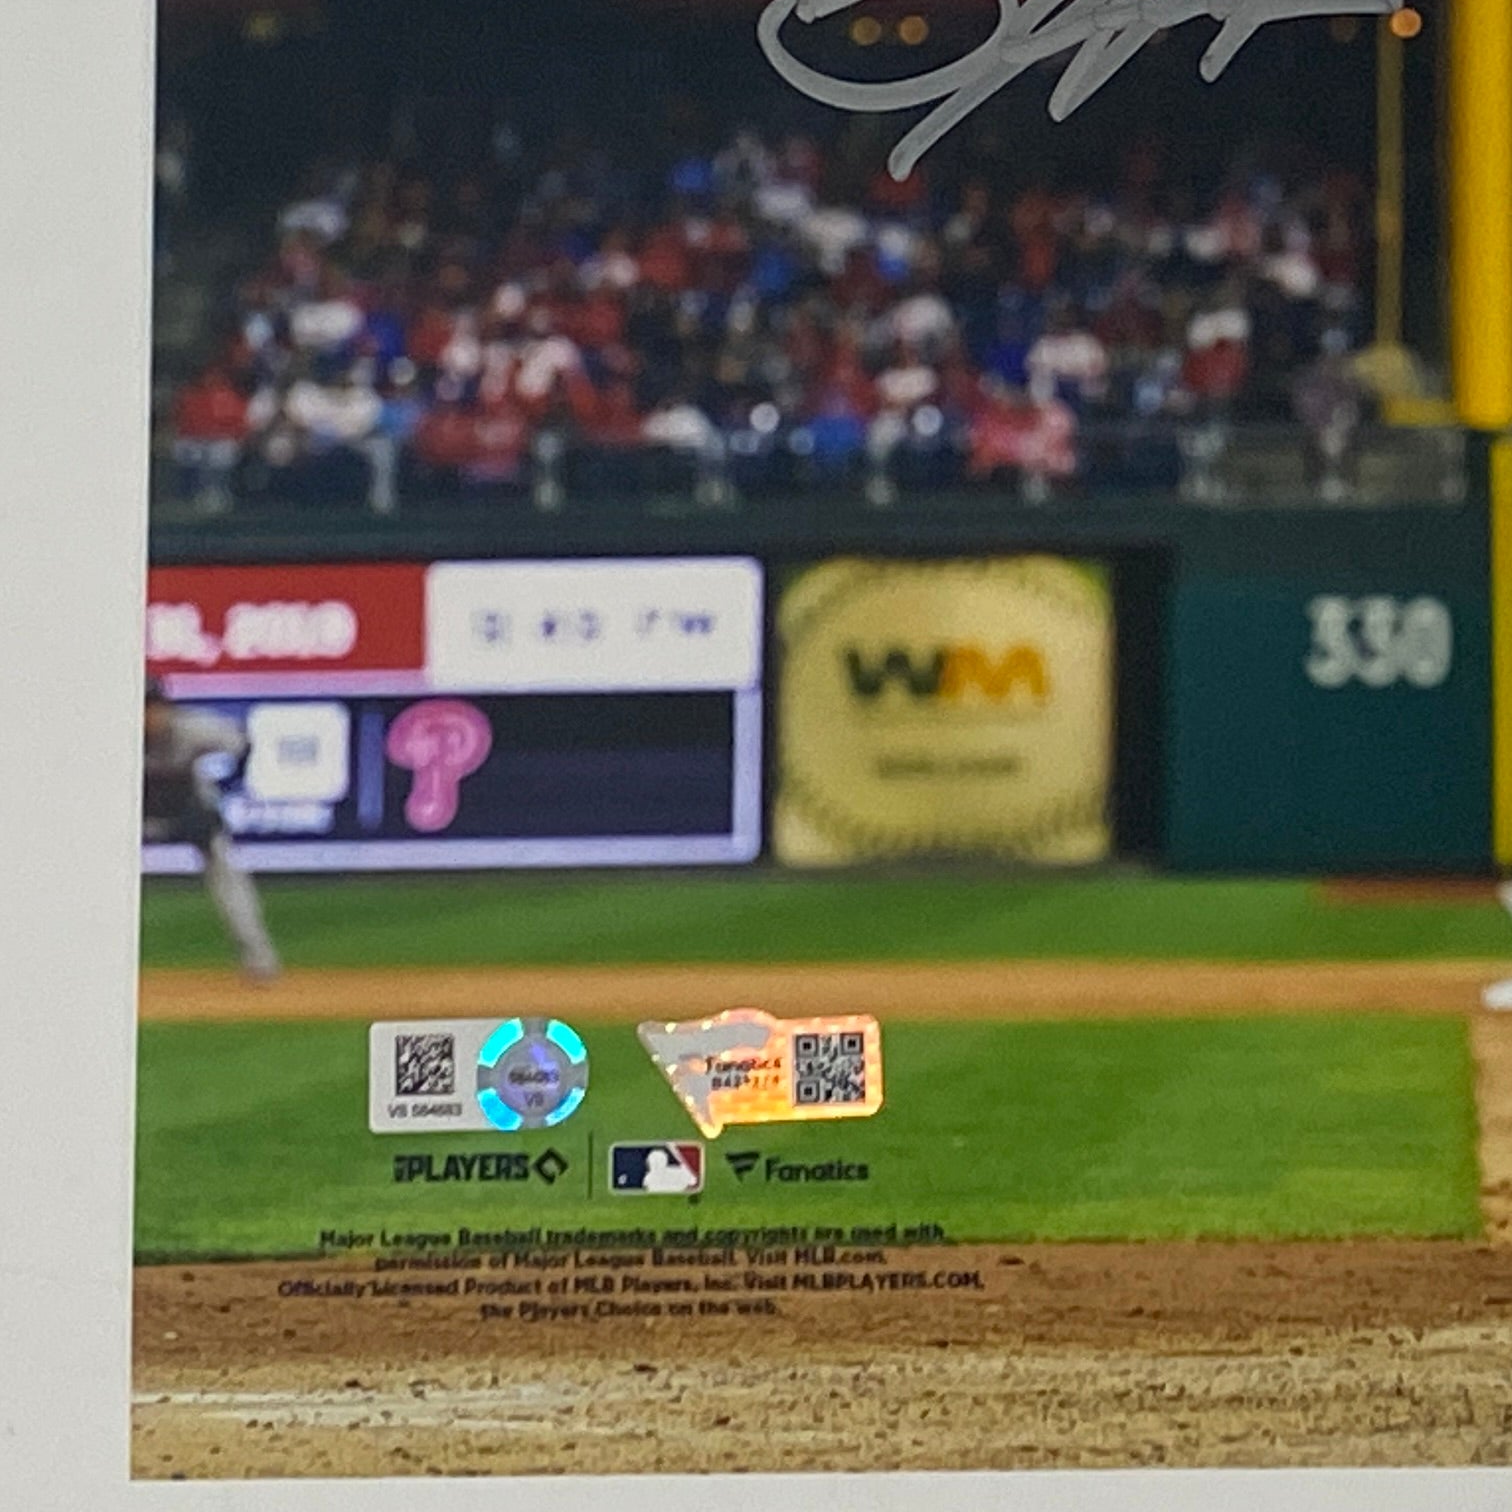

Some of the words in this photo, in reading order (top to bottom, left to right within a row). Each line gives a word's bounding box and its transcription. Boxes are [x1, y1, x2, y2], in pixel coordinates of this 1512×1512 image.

[1304, 593, 1453, 690] 330
[842, 643, 1050, 709] WM
[764, 1156, 870, 1183] Fanatics
[319, 1227, 375, 1249] Major
[379, 1227, 452, 1250] League
[457, 1225, 543, 1246] Baseball
[572, 1249, 646, 1270] League
